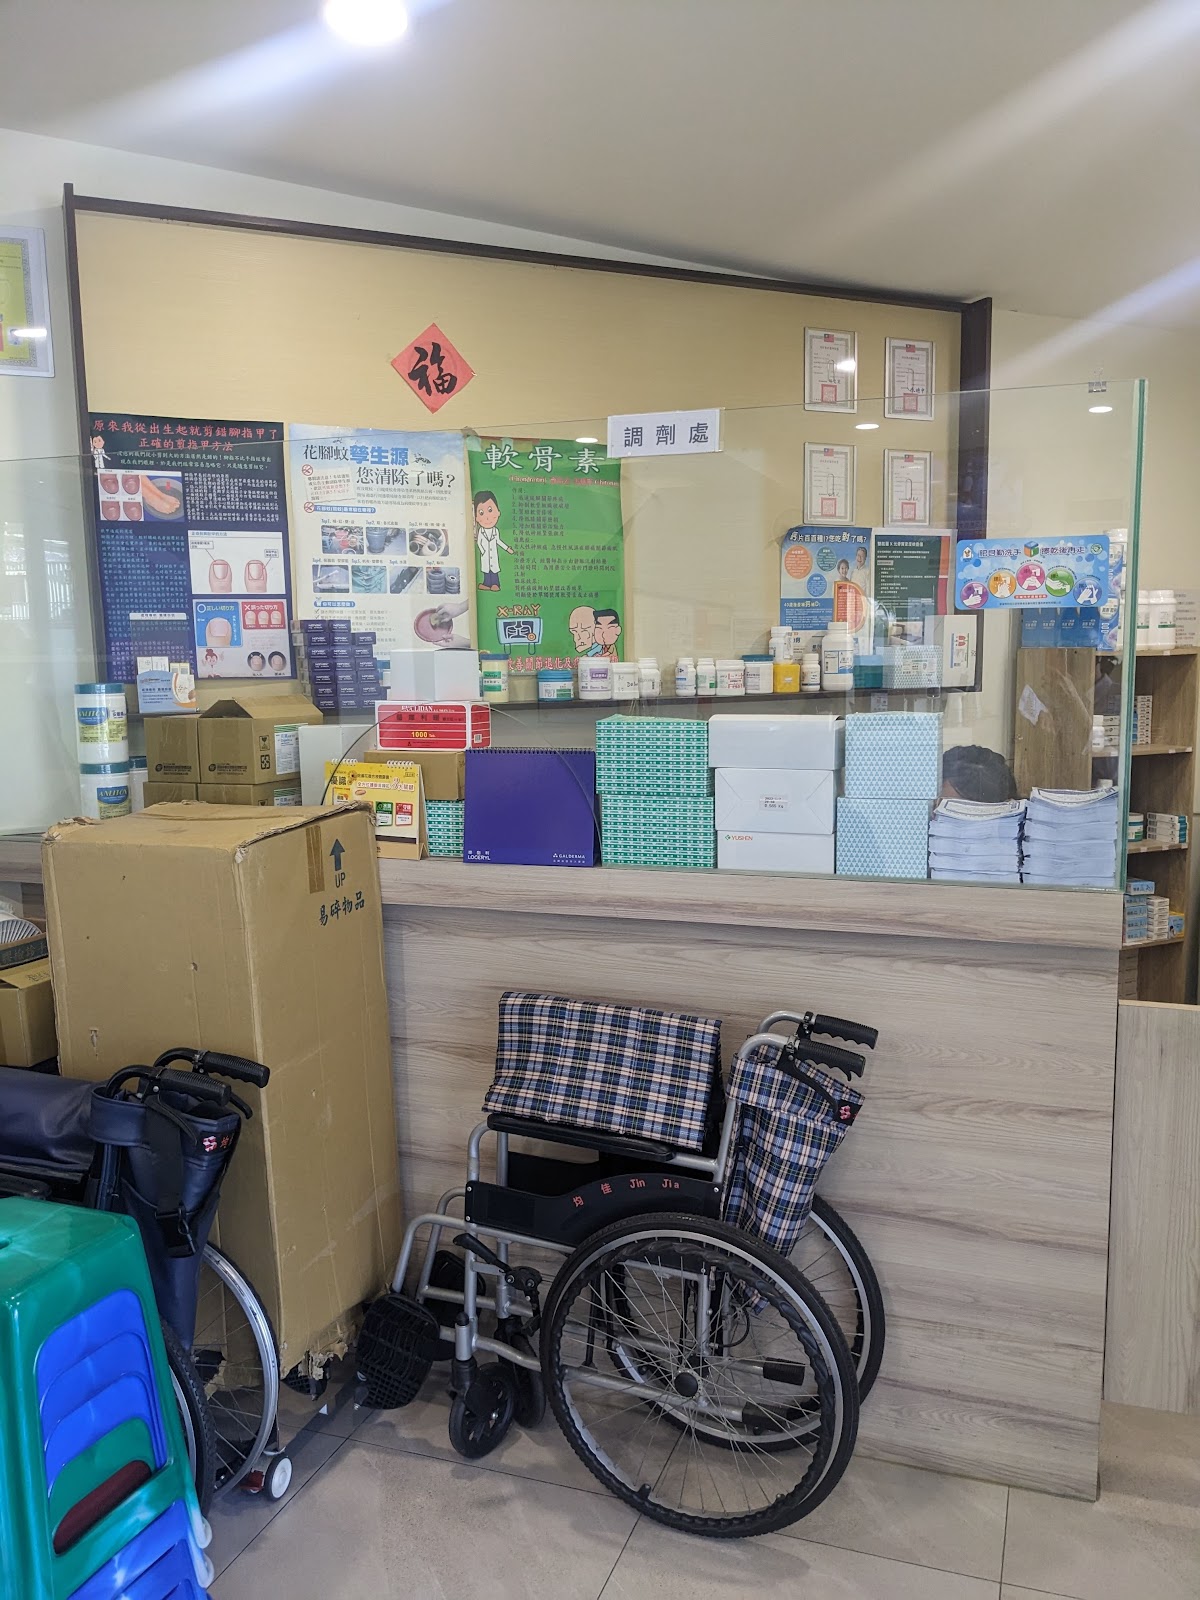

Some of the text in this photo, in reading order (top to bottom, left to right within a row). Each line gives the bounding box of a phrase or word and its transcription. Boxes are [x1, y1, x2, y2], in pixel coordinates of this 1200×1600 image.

[408, 342, 457, 396] 福
[624, 422, 709, 448] 調劑處
[481, 444, 605, 474] 軟骨素
[356, 467, 455, 488] 您清除了嗎?
[496, 603, 541, 618] X-RAY
[335, 872, 346, 888] UP
[319, 890, 365, 926] 易碎物品
